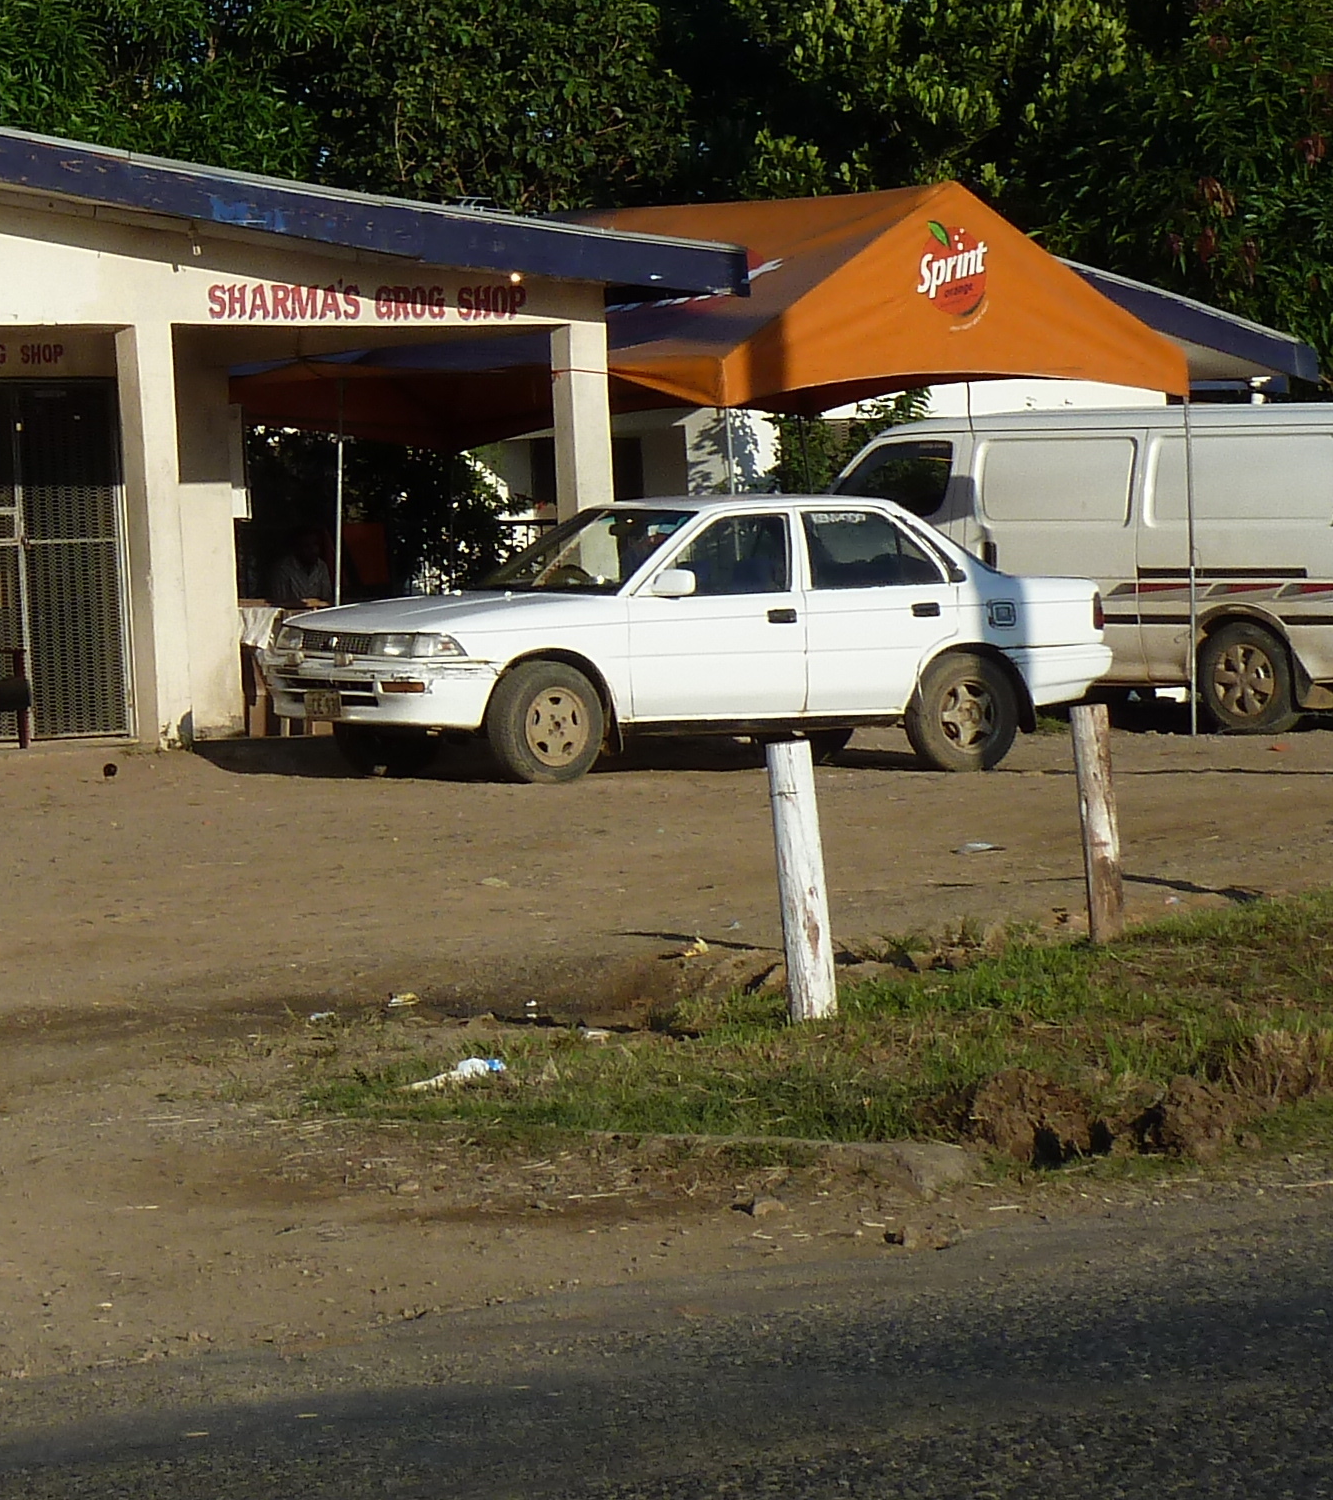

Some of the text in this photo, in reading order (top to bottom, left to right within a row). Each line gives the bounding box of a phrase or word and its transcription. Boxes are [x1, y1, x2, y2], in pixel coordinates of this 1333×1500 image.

[917, 241, 988, 299] Sprint
[208, 278, 527, 321] SHARMA'S GROG SHOP
[20, 343, 64, 364] SHOP
